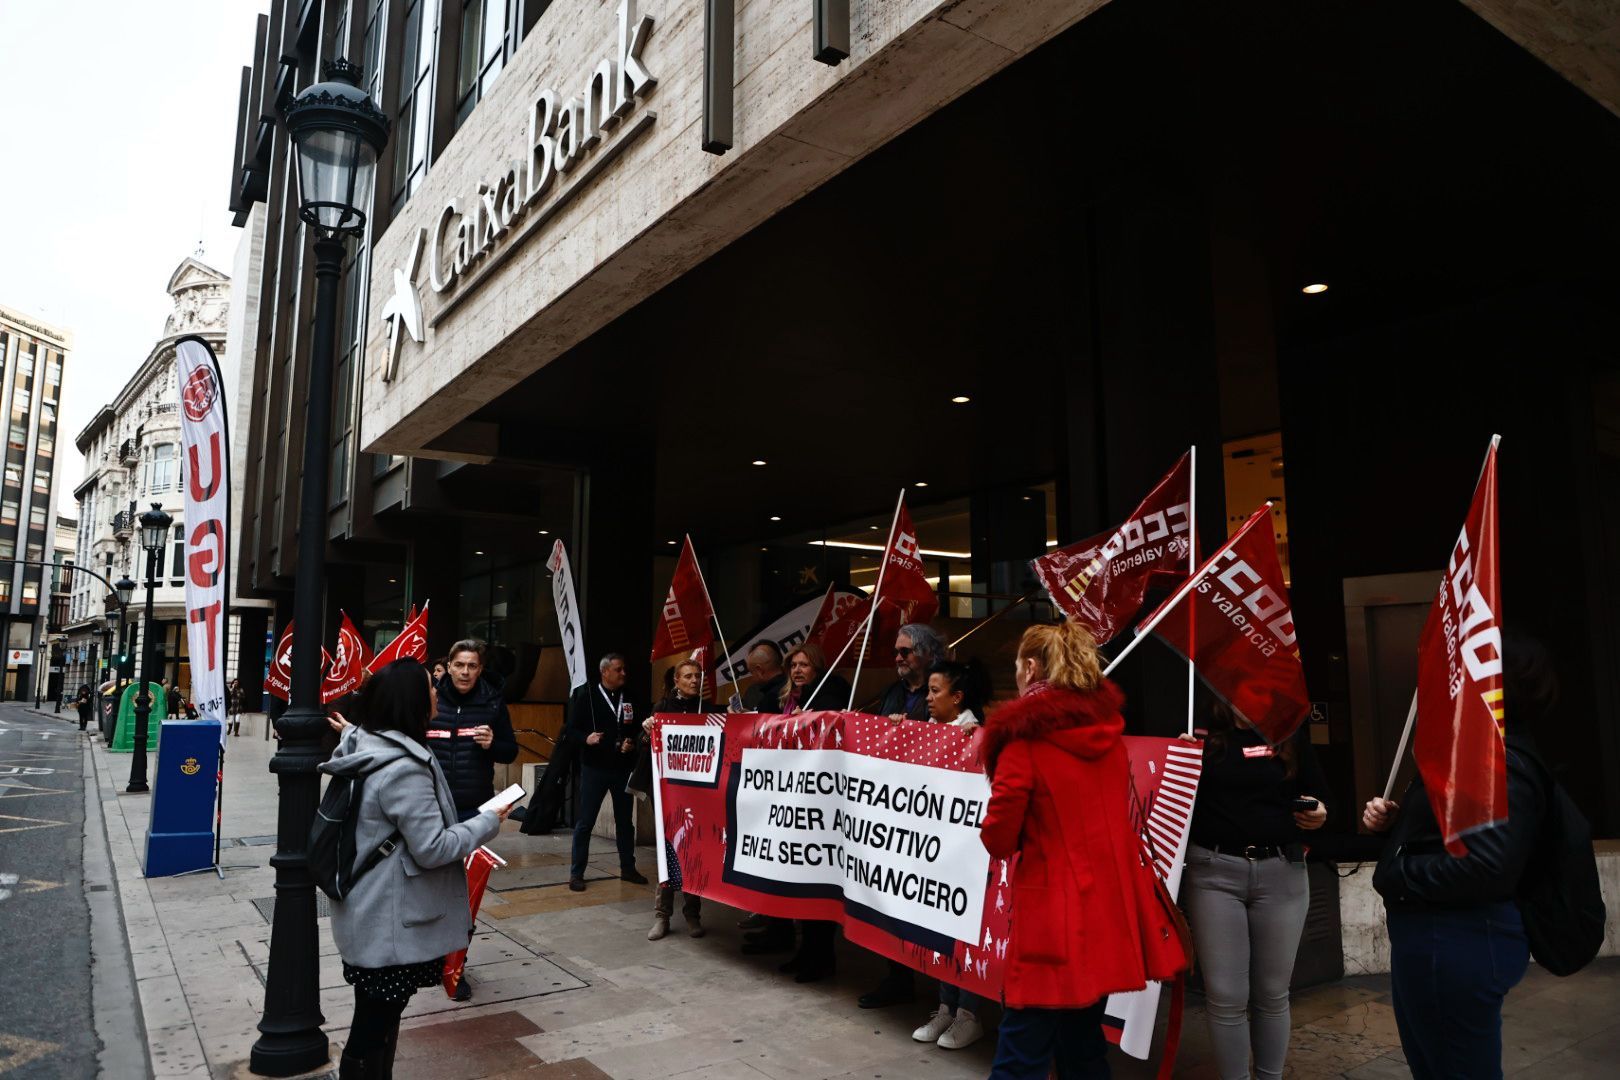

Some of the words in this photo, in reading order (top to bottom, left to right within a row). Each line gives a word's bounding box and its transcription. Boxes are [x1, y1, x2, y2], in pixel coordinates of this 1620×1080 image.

[429, 0, 658, 293] CaixaBank
[1211, 592, 1278, 658] valencià
[667, 734, 706, 753] SALARIO
[667, 751, 714, 773] CONFLICTO
[743, 768, 774, 792] POR
[777, 770, 794, 793] LA
[949, 797, 983, 829] DEL
[768, 804, 826, 831] PODER
[832, 808, 941, 863] AQUISITIVO
[741, 834, 760, 858] EN
[759, 837, 775, 862] EL
[846, 854, 968, 917] FINANCIERO
